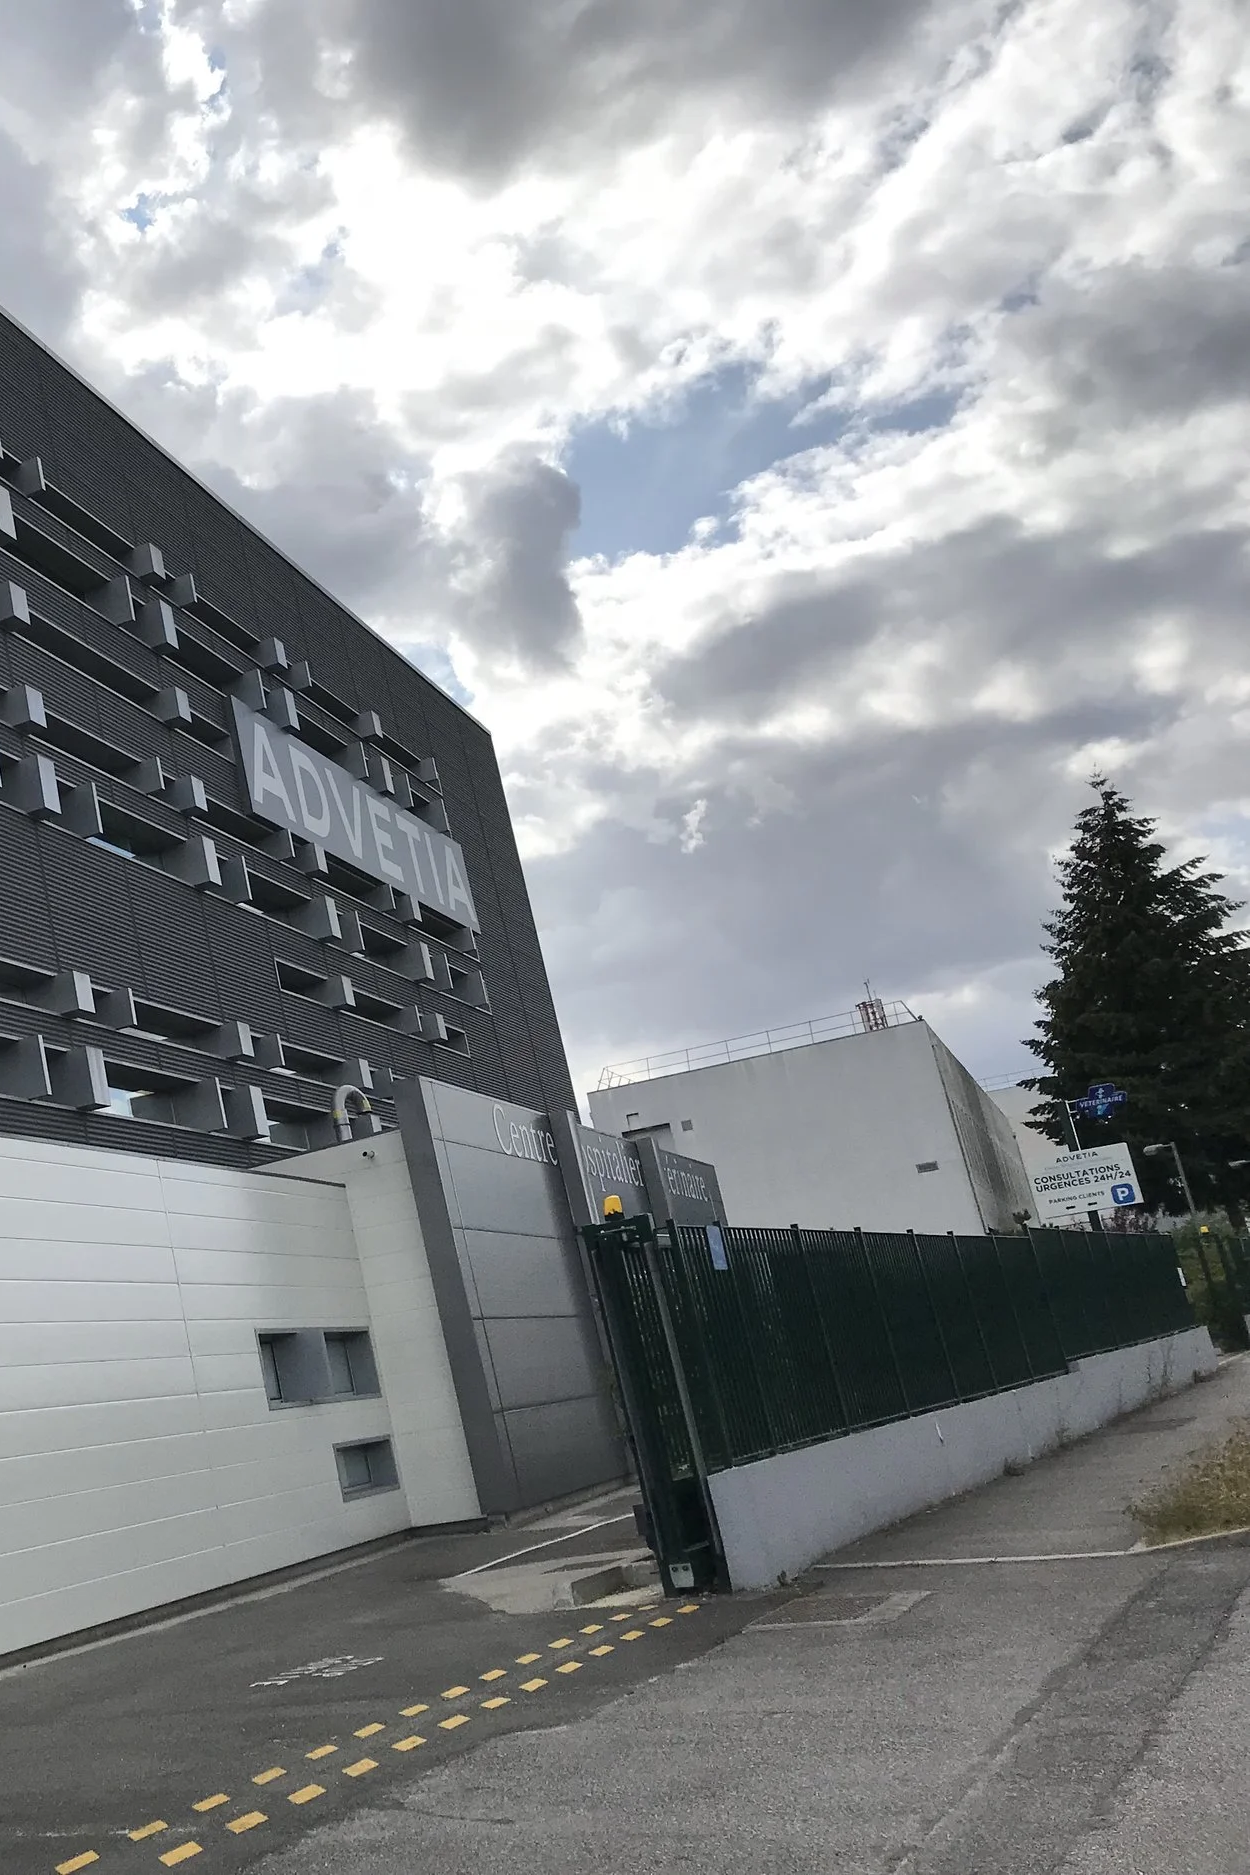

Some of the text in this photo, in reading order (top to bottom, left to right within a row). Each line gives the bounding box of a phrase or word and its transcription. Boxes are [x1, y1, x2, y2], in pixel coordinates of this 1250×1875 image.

[253, 721, 477, 922] ADVETIA
[493, 1103, 558, 1166] Centre
[581, 1136, 644, 1192] spitalier
[1055, 1151, 1099, 1164] ADVETIA
[1033, 1163, 1121, 1185] CONSULTATIONS
[1035, 1170, 1131, 1193] URGENCES 24H/24
[1048, 1190, 1105, 1205] PARKING CLIENTS
[1116, 1187, 1129, 1201] P
